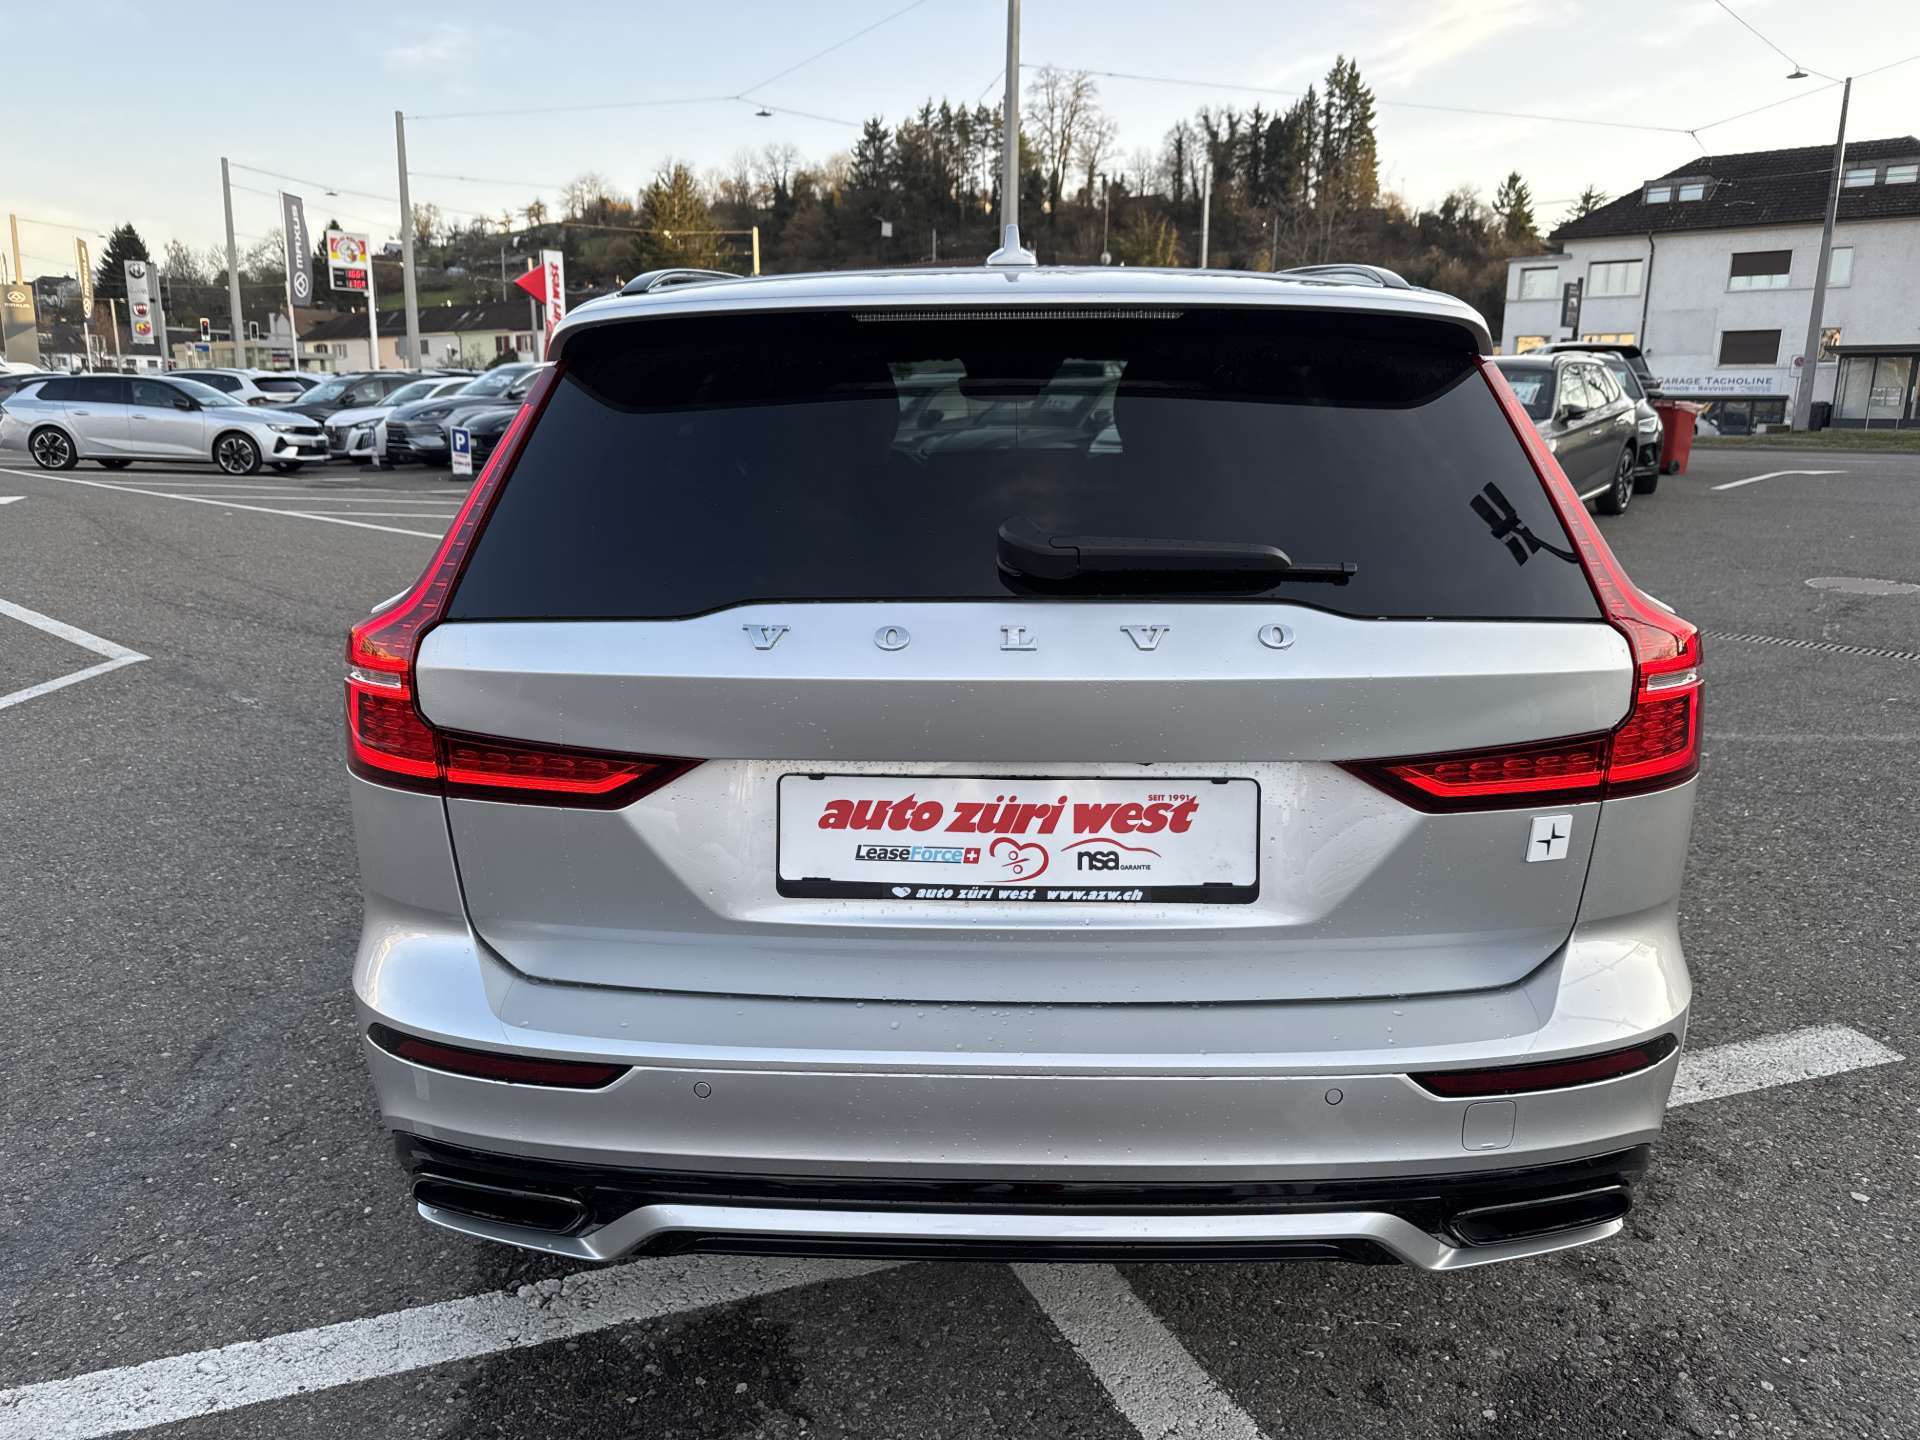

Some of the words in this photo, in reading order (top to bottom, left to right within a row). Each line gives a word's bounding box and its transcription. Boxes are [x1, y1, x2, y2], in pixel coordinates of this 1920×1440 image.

[1704, 376, 1773, 386] TACHOLINE
[455, 431, 467, 451] P
[742, 622, 1297, 652] VOLVO
[1147, 793, 1165, 802] SEIT
[1168, 793, 1191, 802] 1991
[818, 792, 944, 832] auto
[944, 794, 1068, 835] züri
[1073, 794, 1200, 835] west
[855, 844, 963, 863] LeaseForce
[1076, 850, 1120, 871] nsa
[916, 887, 954, 899] auto
[957, 886, 994, 899] züri
[997, 887, 1036, 900] west
[1046, 888, 1144, 901] www.azw.ch
